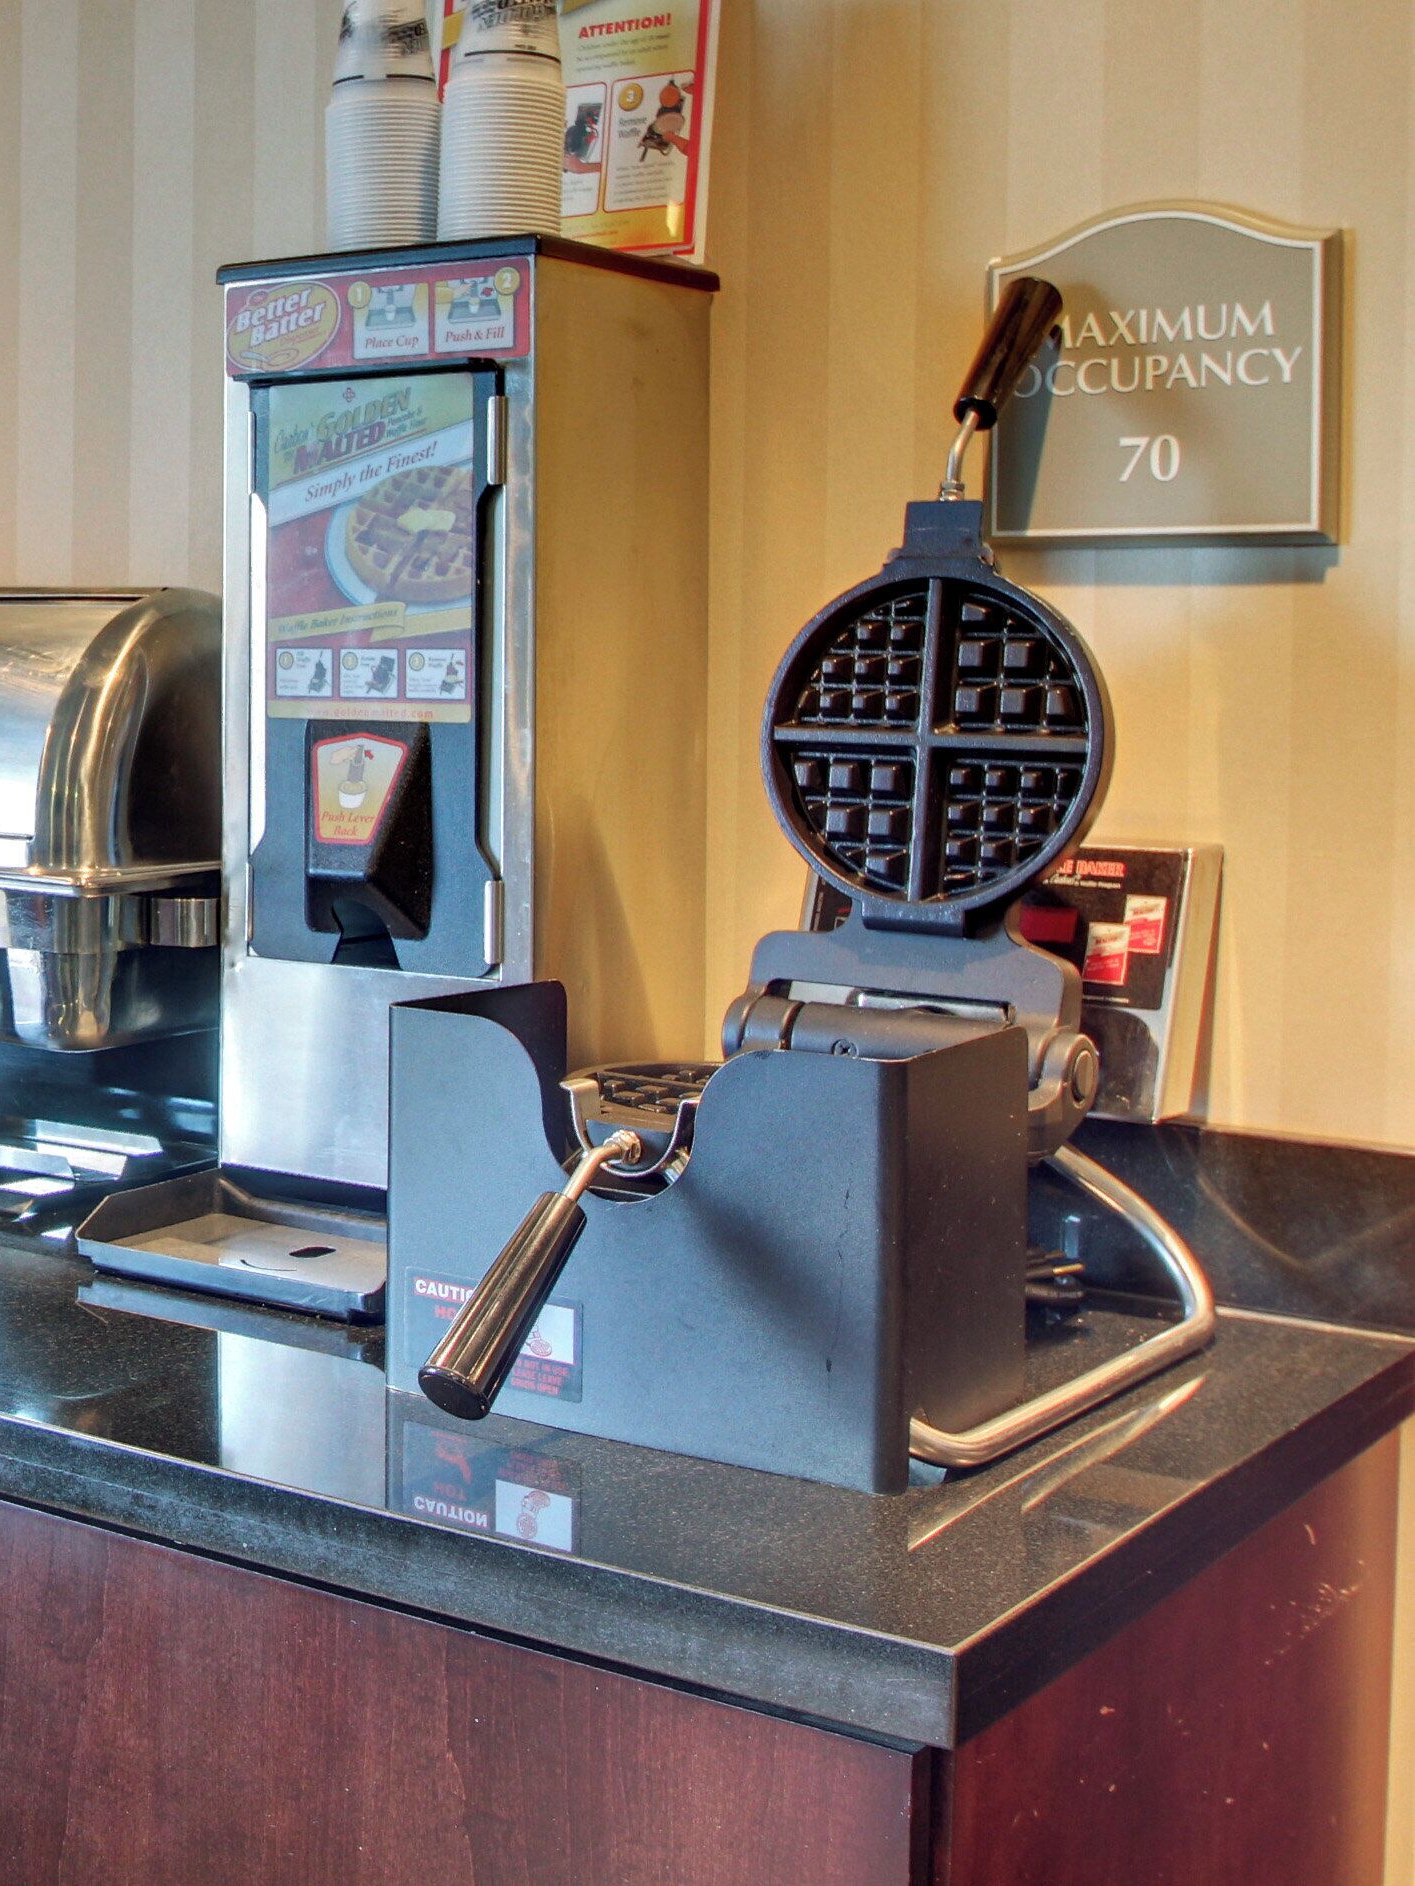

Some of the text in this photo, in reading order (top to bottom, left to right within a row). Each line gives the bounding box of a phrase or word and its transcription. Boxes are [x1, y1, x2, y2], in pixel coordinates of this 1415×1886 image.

[578, 13, 671, 39] ATTENTION!
[236, 287, 312, 333] Better
[249, 302, 326, 348] Batter
[365, 335, 419, 349] Place Cup
[445, 326, 506, 342] Push & Fill
[316, 387, 411, 441] GOLDEN
[293, 421, 386, 475] MALTED
[1119, 434, 1181, 482] 70
[305, 440, 438, 502] Simply the Finest!
[321, 811, 374, 823] Push Lever
[334, 825, 358, 836] Back
[415, 1280, 475, 1302] CAUTI
